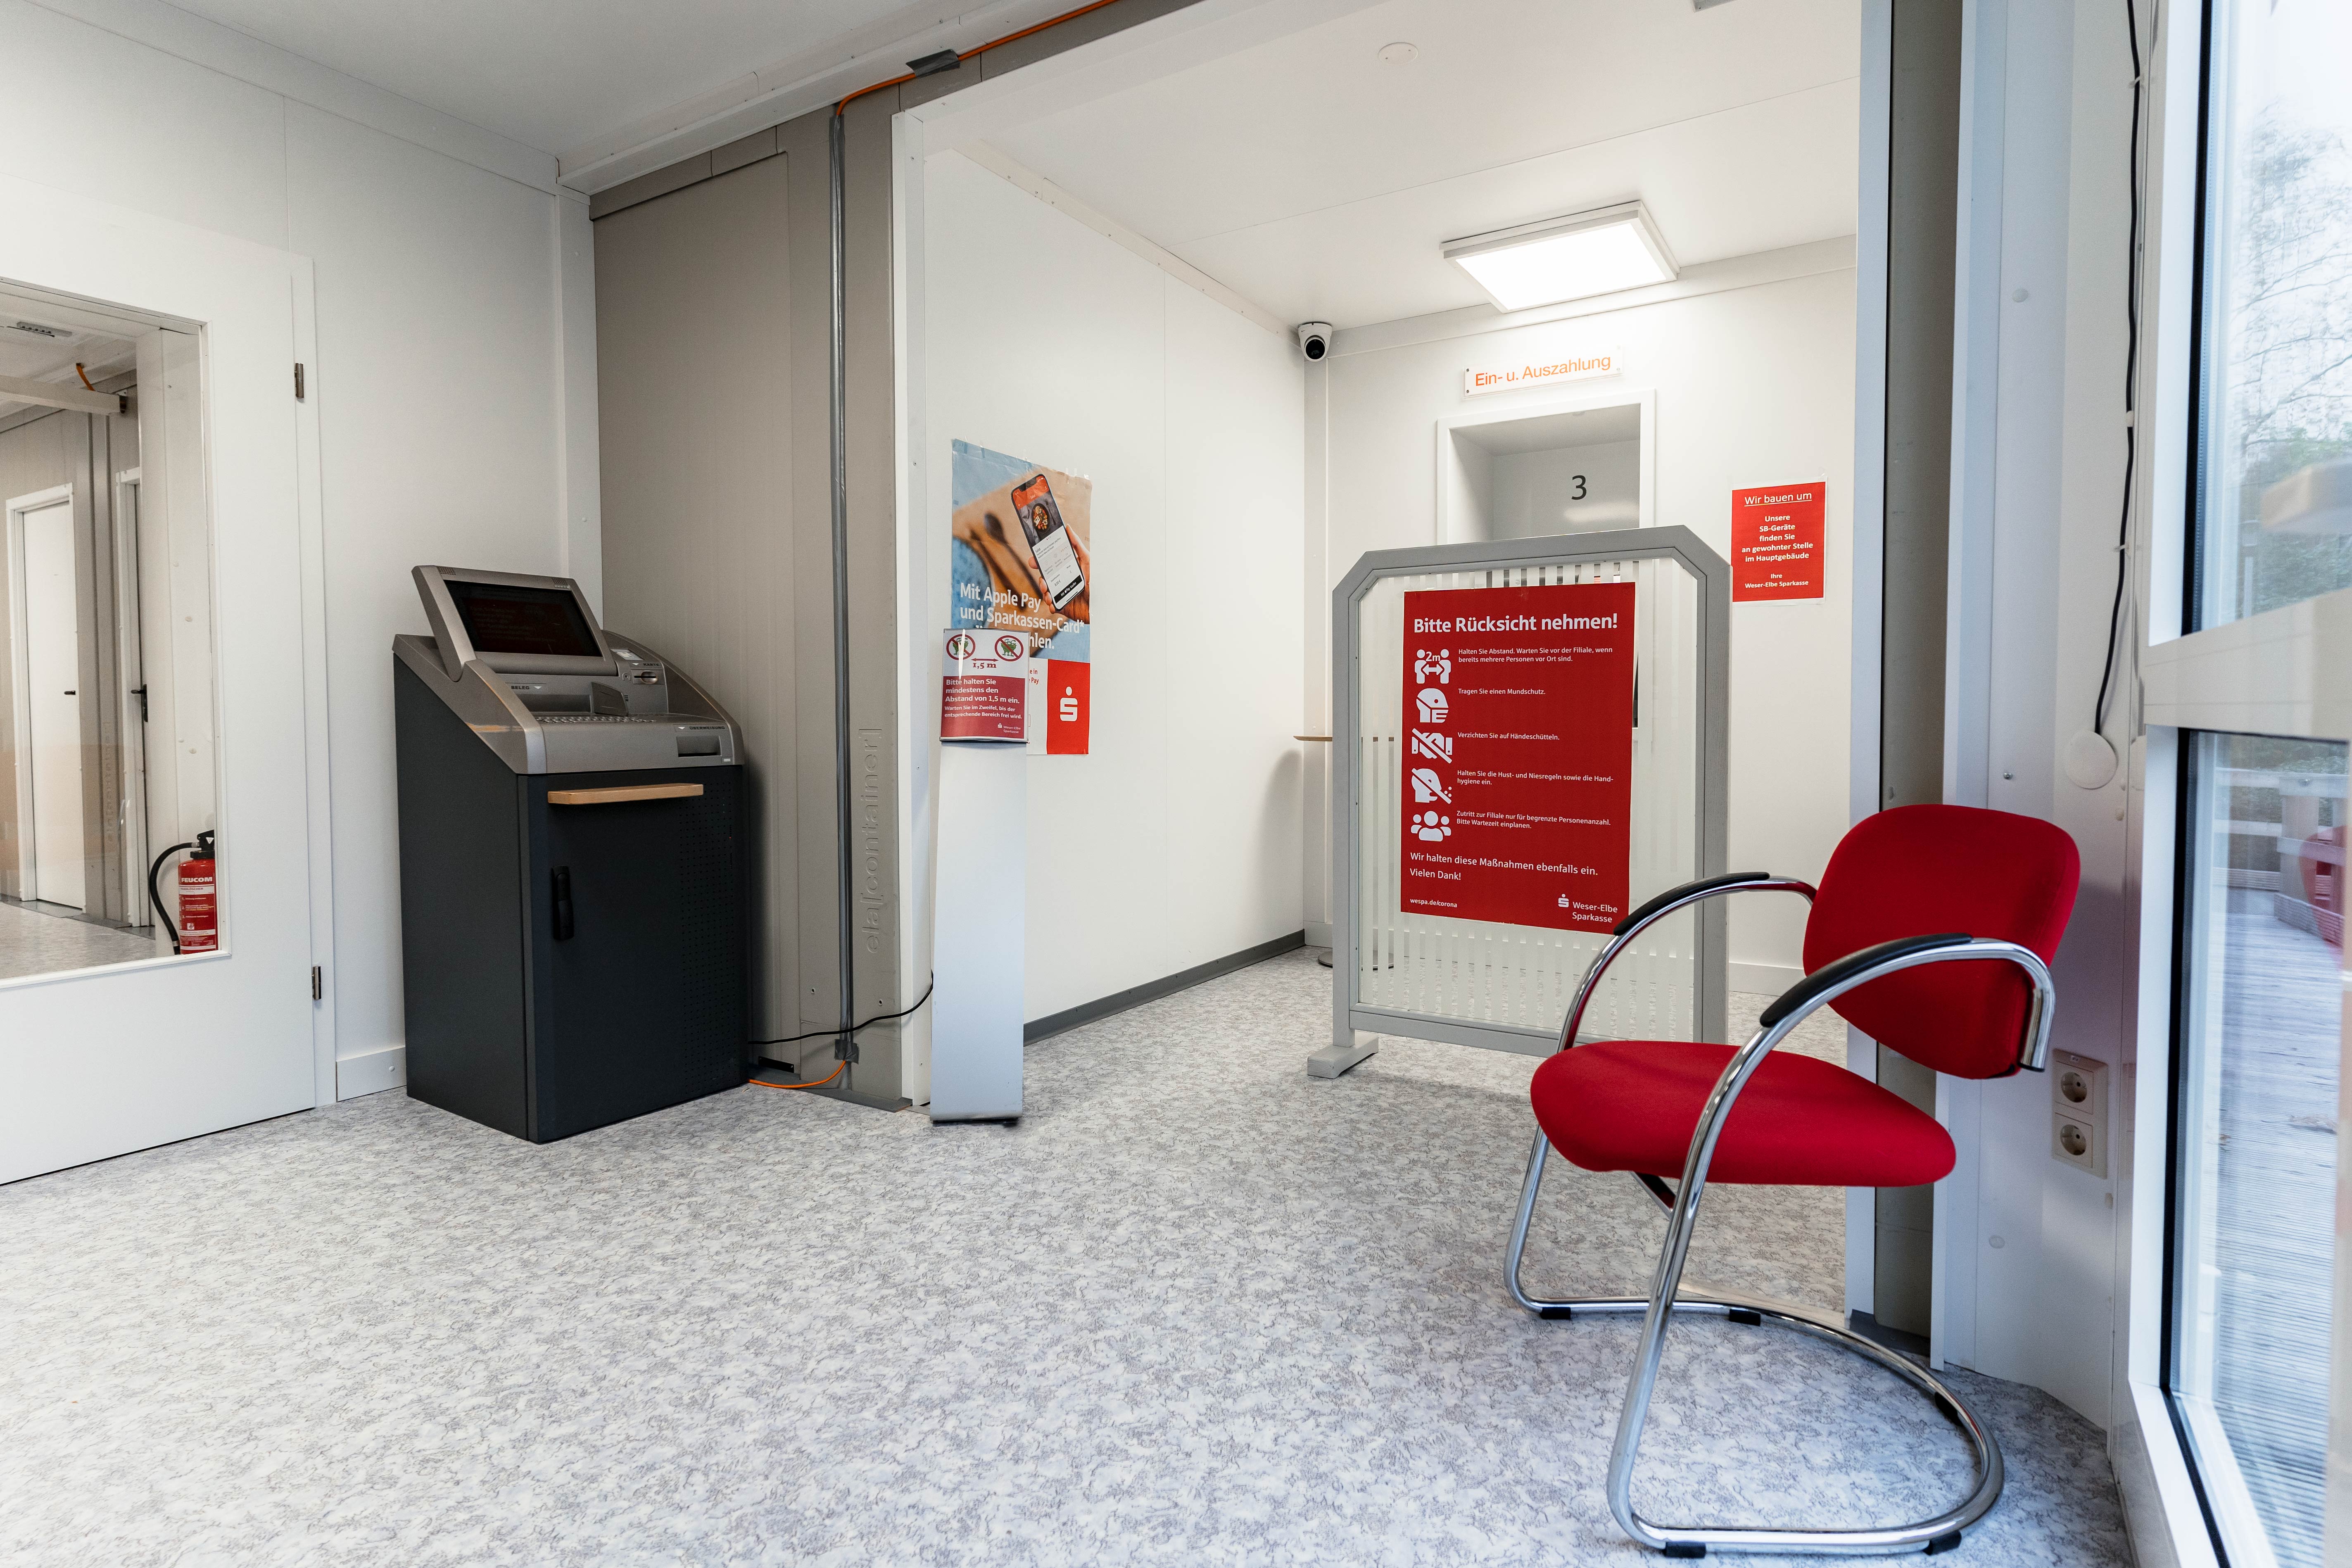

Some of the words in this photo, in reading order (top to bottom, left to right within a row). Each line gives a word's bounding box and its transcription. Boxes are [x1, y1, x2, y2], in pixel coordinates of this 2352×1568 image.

[1476, 373, 1502, 386] Ein-
[1507, 372, 1518, 381] u.
[1522, 357, 1610, 379] Auszahlung
[1572, 475, 1587, 500] 3
[1744, 497, 1761, 505] Wir
[1765, 494, 1793, 504] bauen
[1752, 544, 1791, 553] gewohnter
[1756, 552, 1809, 562] Hauptgebäude
[961, 582, 981, 601] Mit
[984, 586, 1018, 606] Apple
[1022, 593, 1041, 613] Pay
[960, 605, 984, 621] und
[1415, 618, 1451, 632] Bitte
[1456, 615, 1537, 632] Rücksicht
[1542, 613, 1617, 630] nehmen!
[1029, 632, 1054, 649] hlen.
[1425, 651, 1440, 661] 2m
[1559, 817, 1611, 825] Personenanzahl.
[1427, 853, 1452, 863] halten
[1455, 856, 1477, 865] diese
[1480, 858, 1533, 870] Maßnahmen
[1537, 862, 1578, 873] ebenfalls
[1581, 867, 1597, 875] ein.
[1410, 868, 1435, 877] Vielen
[1438, 871, 1461, 880] Dank!
[1410, 899, 1457, 908] wespa.de/corona
[1573, 902, 1618, 913] Weser-Elbe
[1573, 912, 1612, 922] Sparkasse
